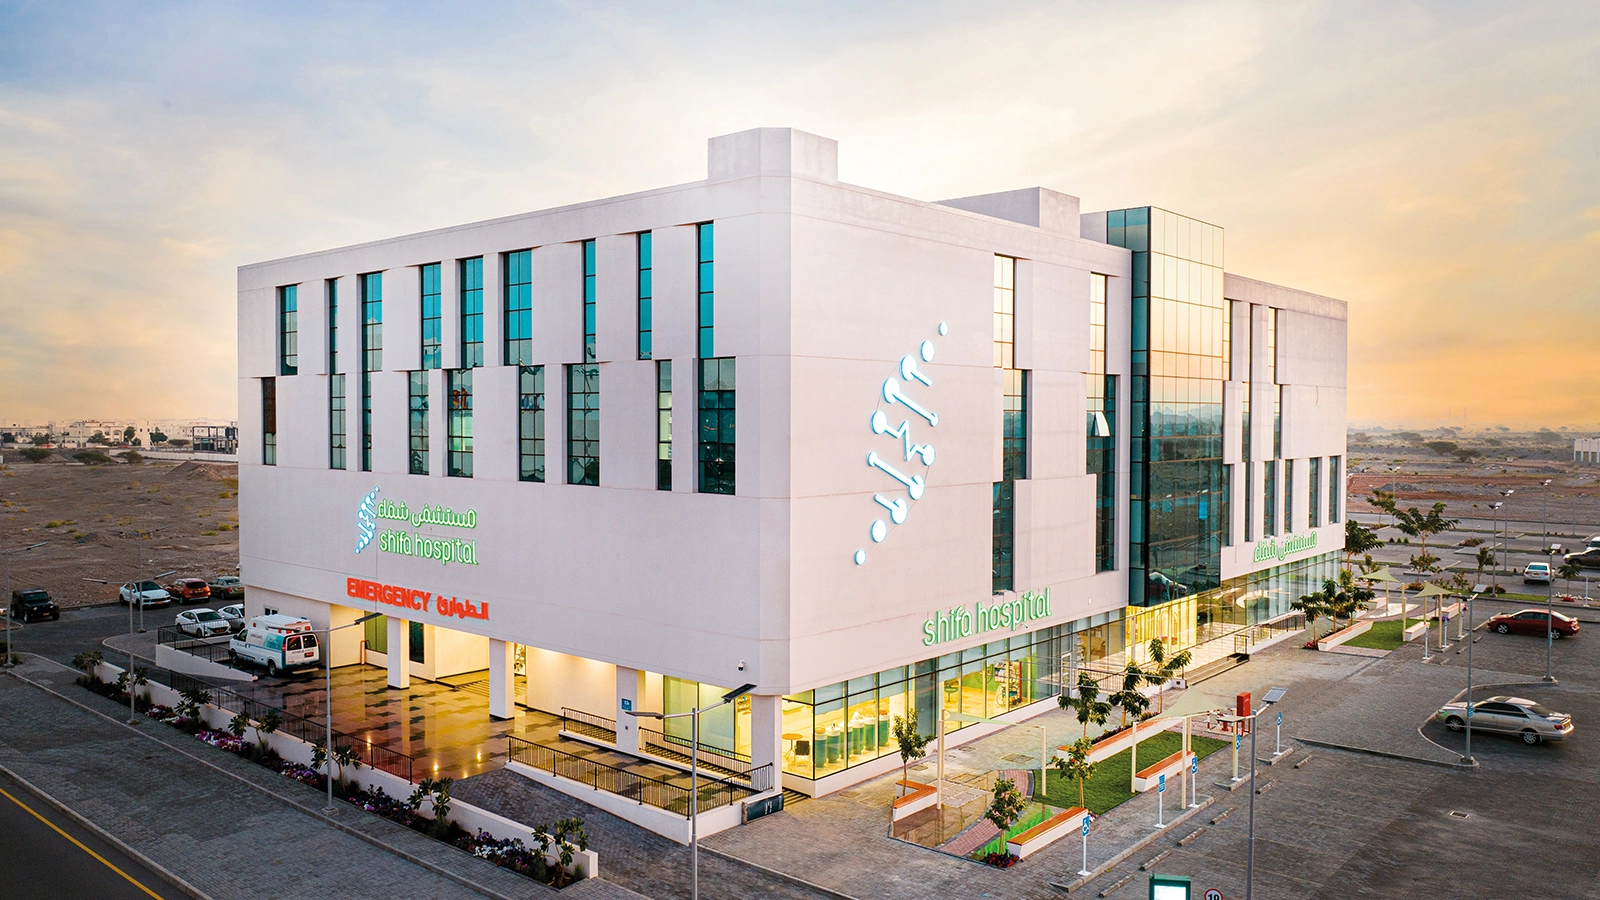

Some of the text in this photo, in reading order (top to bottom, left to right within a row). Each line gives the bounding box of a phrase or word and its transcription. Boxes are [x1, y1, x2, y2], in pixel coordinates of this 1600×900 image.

[411, 503, 477, 528] مستشفى
[379, 529, 478, 565] shifa hospital
[346, 577, 431, 612] EMERGENCY
[436, 595, 489, 620] الطوارئ
[923, 587, 1052, 646] shifa hospital
